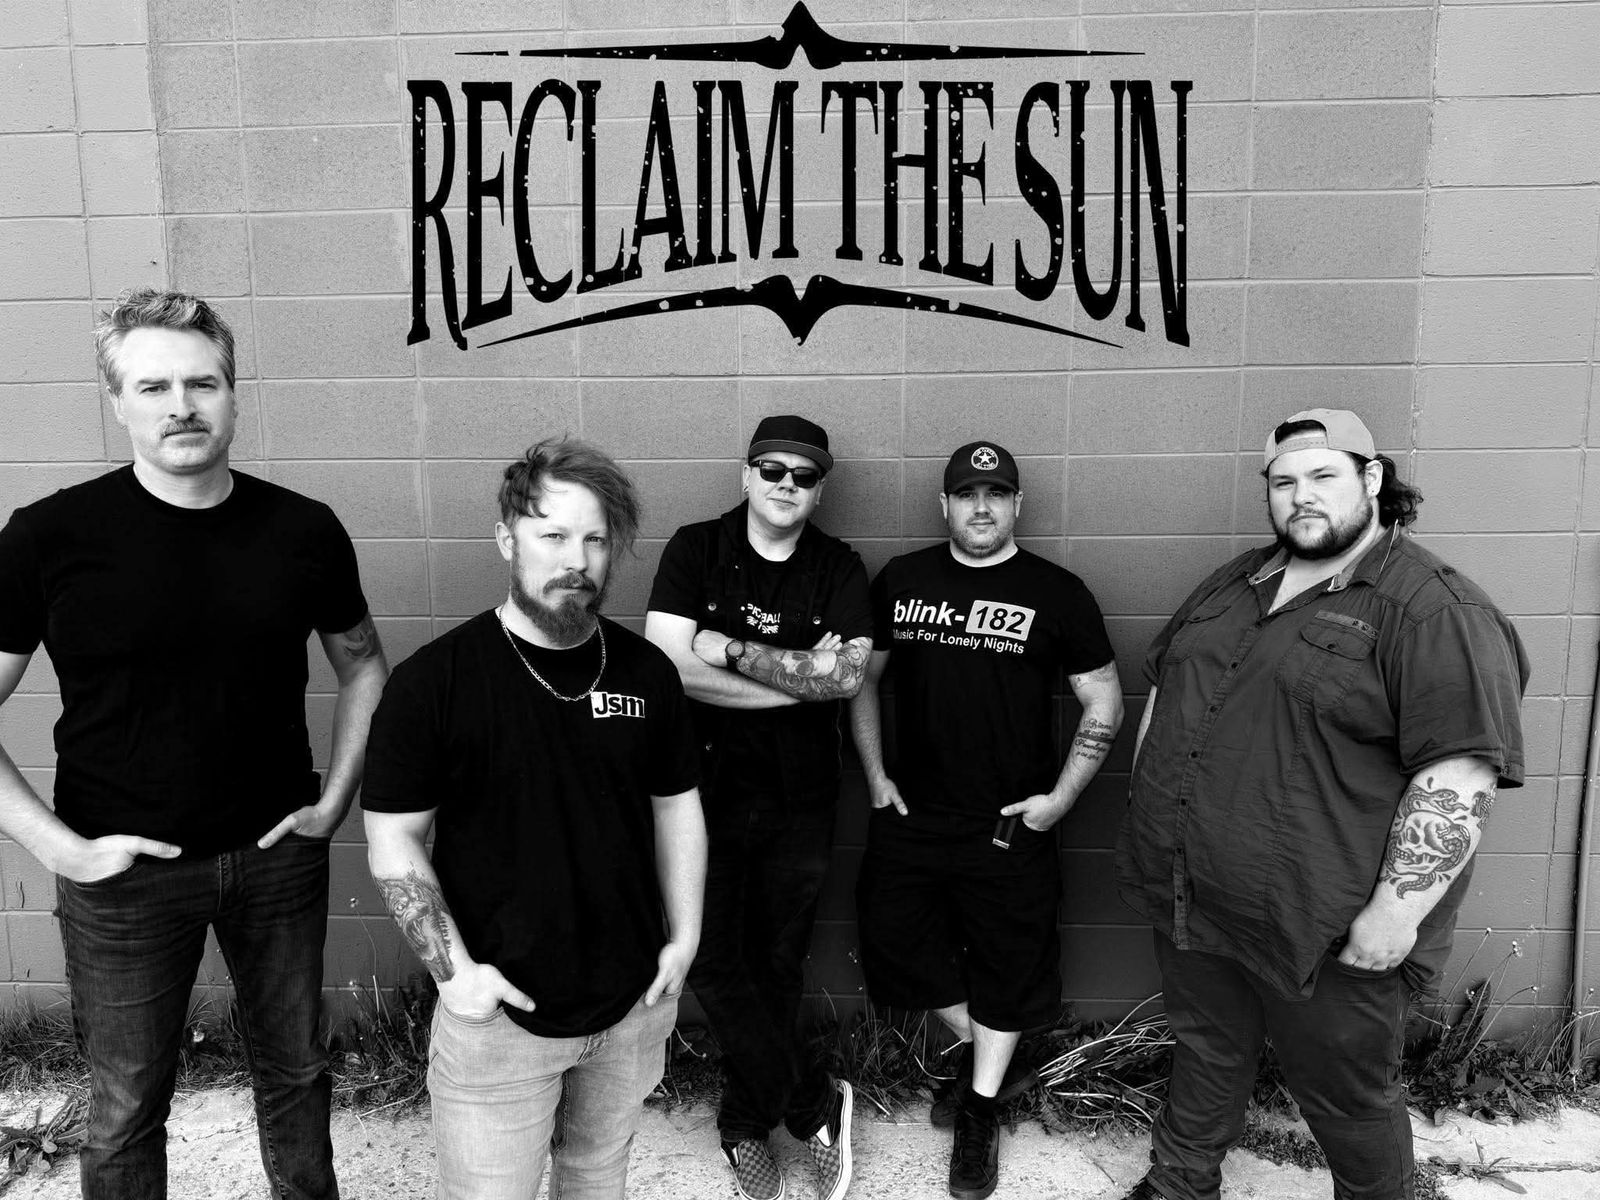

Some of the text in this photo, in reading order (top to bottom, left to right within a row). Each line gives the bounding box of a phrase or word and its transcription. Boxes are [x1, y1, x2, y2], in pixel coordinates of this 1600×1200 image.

[893, 599, 1029, 636] blink-182
[917, 629, 938, 642] For
[939, 632, 981, 650] Lonely
[983, 637, 1025, 654] Nights
